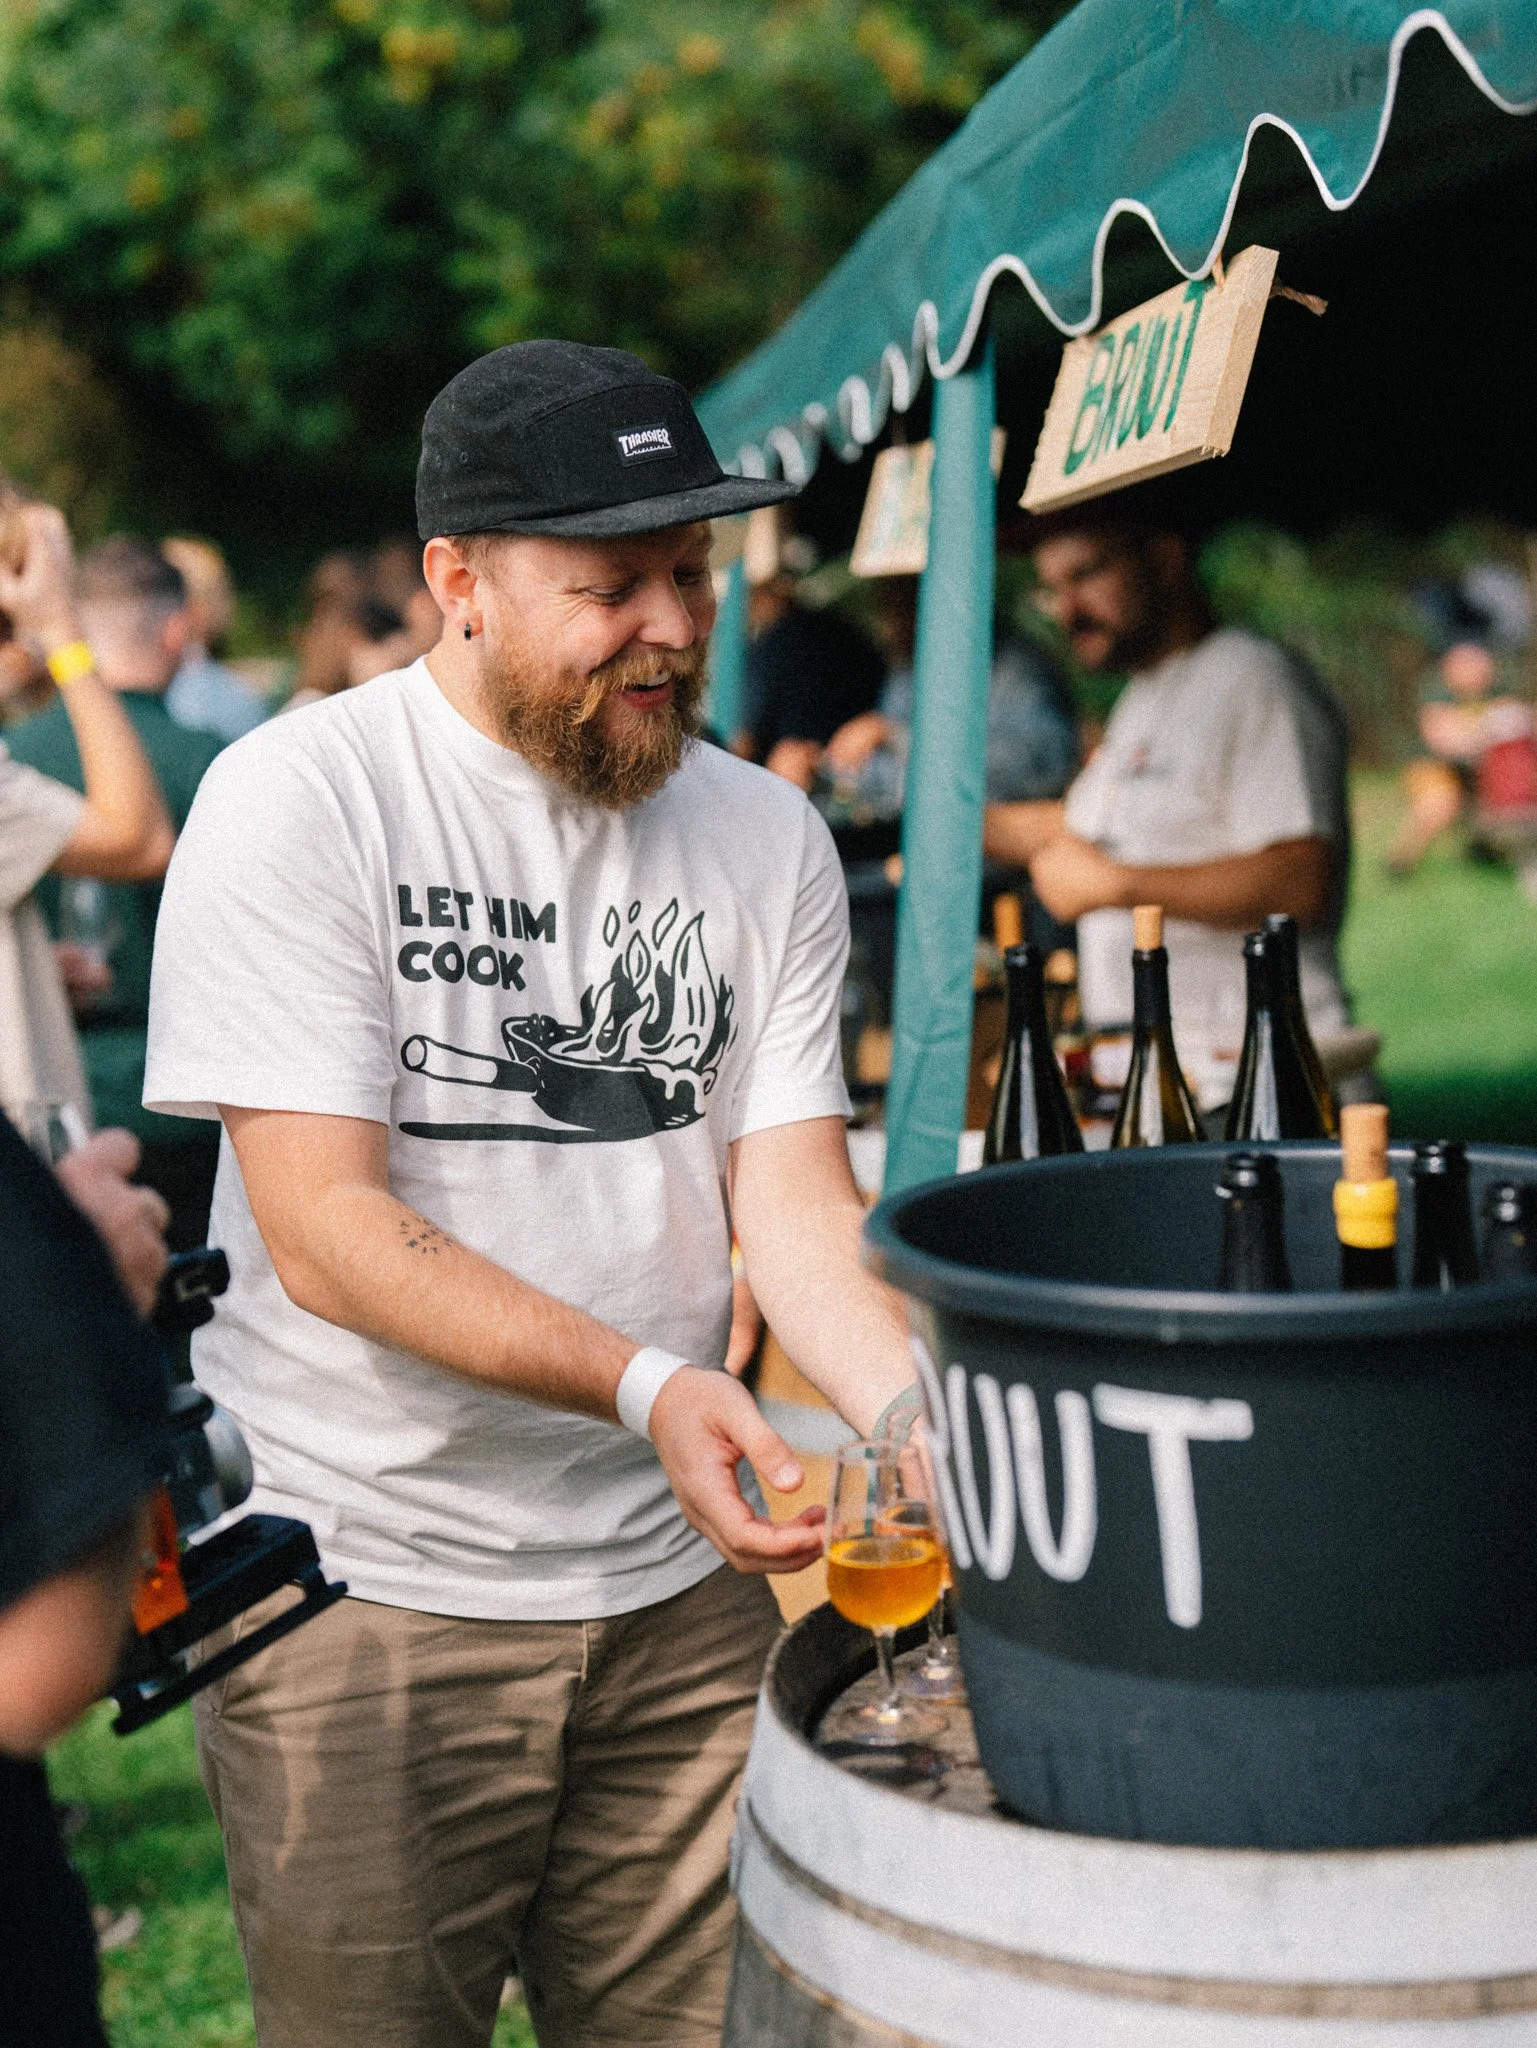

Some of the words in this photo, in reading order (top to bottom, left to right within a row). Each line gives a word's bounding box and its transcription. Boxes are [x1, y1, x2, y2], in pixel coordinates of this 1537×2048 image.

[618, 428, 671, 454] THRASHER
[398, 884, 474, 930] LET
[485, 896, 557, 943] HIM
[397, 941, 526, 992] COOK
